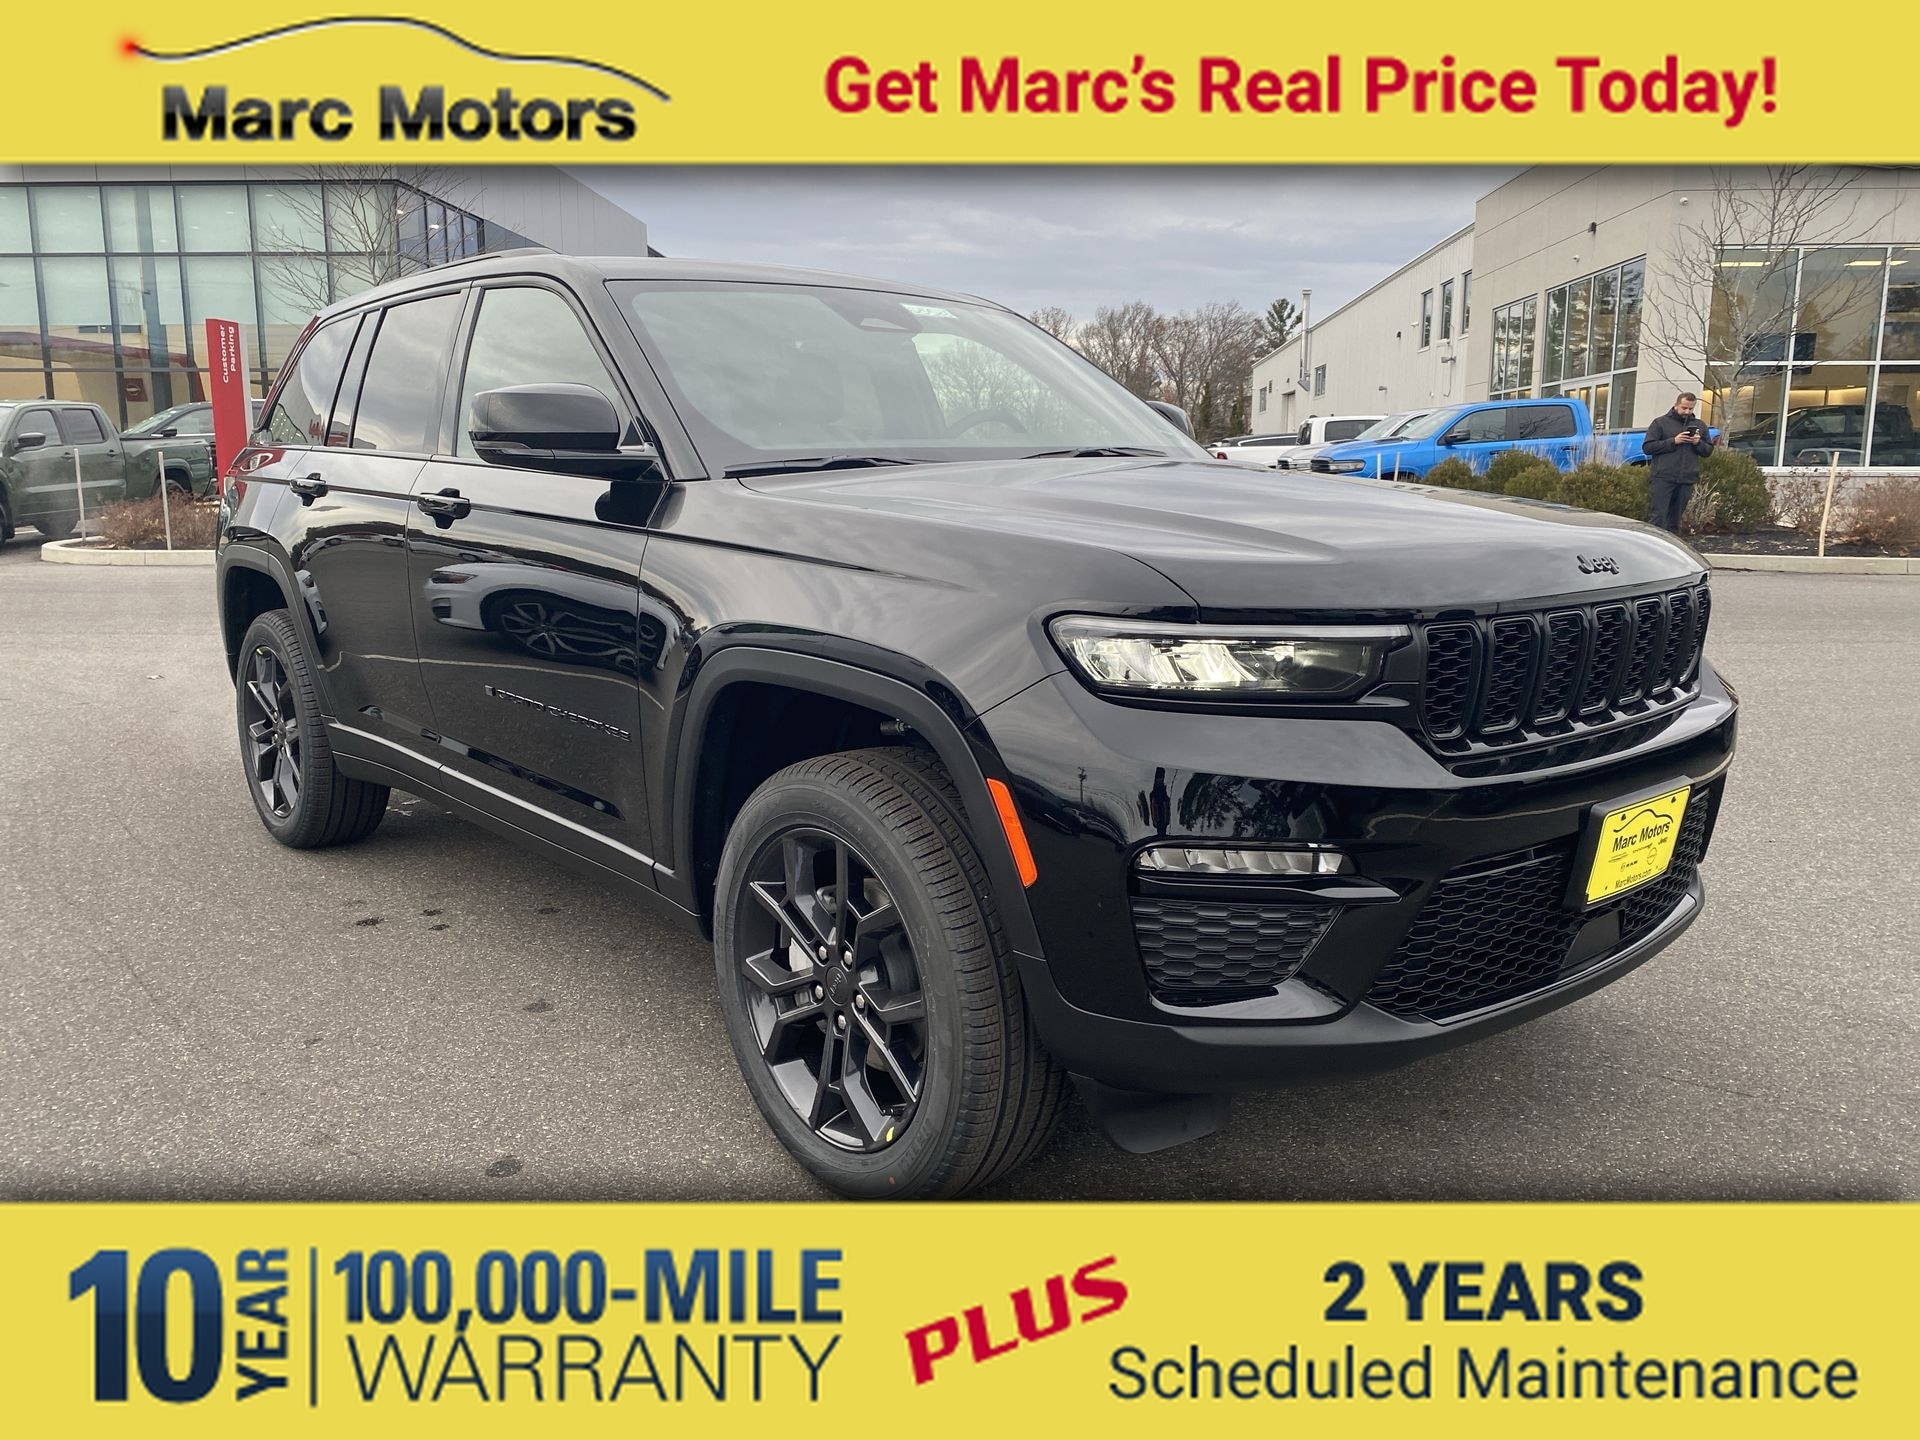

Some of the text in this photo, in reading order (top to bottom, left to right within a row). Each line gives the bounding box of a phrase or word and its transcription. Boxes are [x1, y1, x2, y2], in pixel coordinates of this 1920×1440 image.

[219, 324, 229, 383] Customer
[228, 326, 236, 372] Parking
[1577, 555, 1619, 575] Jeep
[1613, 835, 1637, 852] Marc
[1639, 822, 1670, 843] Motors
